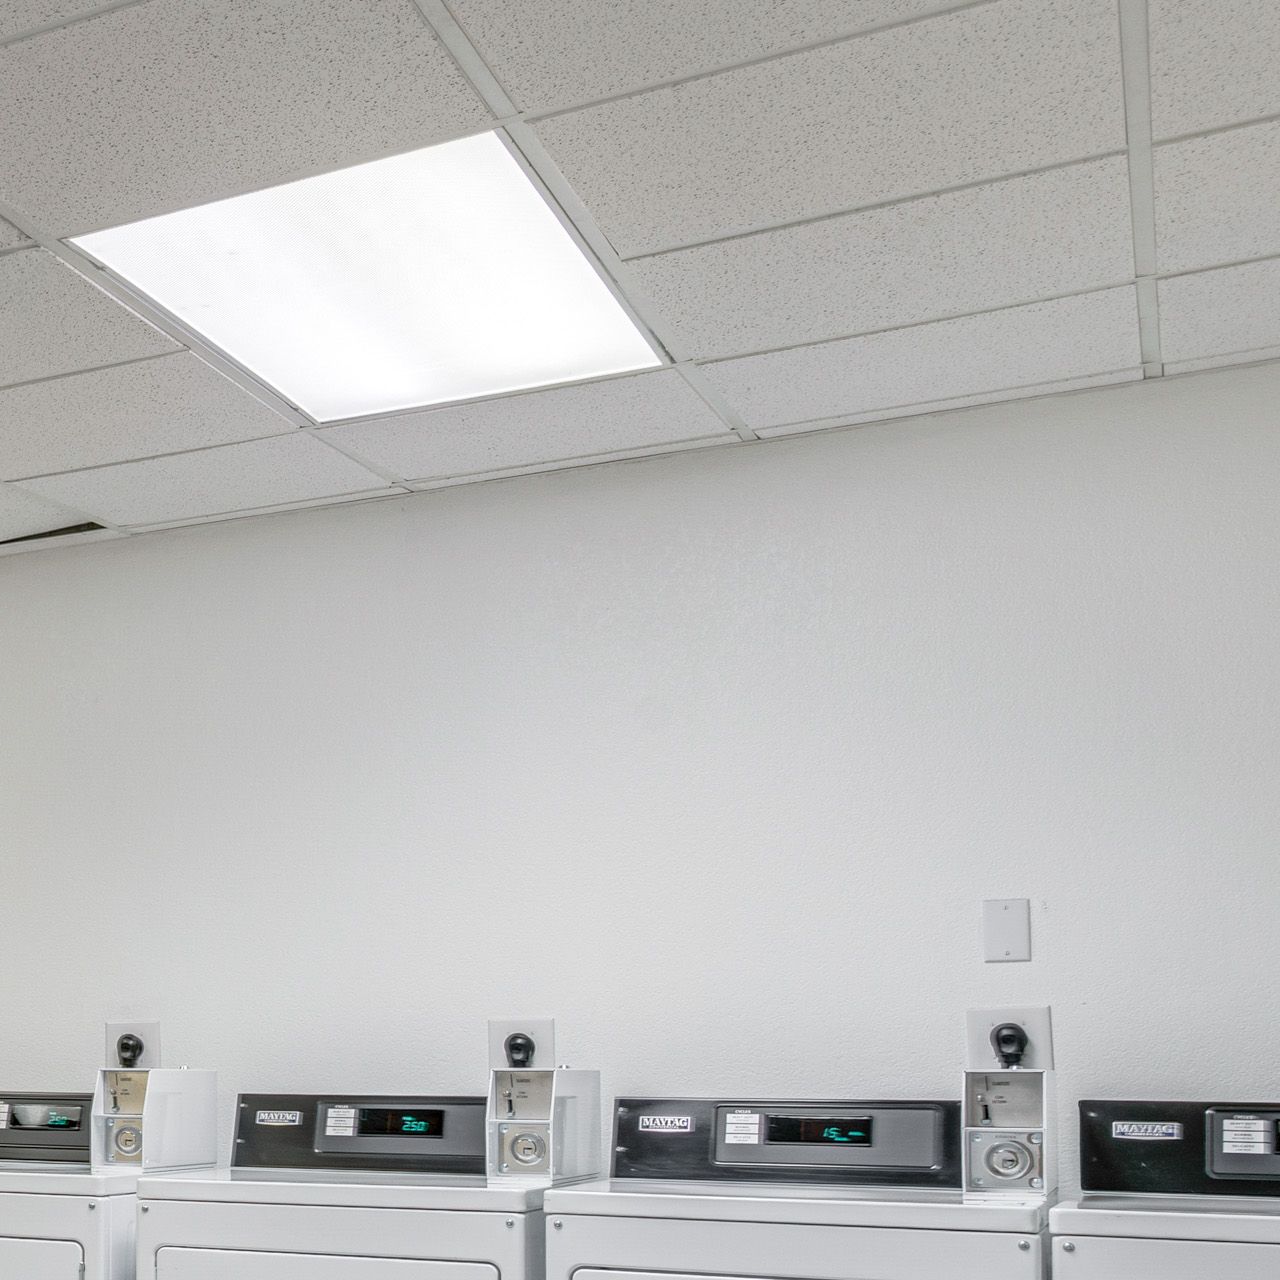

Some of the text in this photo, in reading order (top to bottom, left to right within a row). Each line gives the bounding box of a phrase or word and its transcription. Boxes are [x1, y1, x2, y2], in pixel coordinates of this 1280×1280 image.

[259, 1112, 296, 1120] MAYTAG
[642, 1118, 688, 1127] MAYTAG
[1115, 1124, 1174, 1133] MAYTAG
